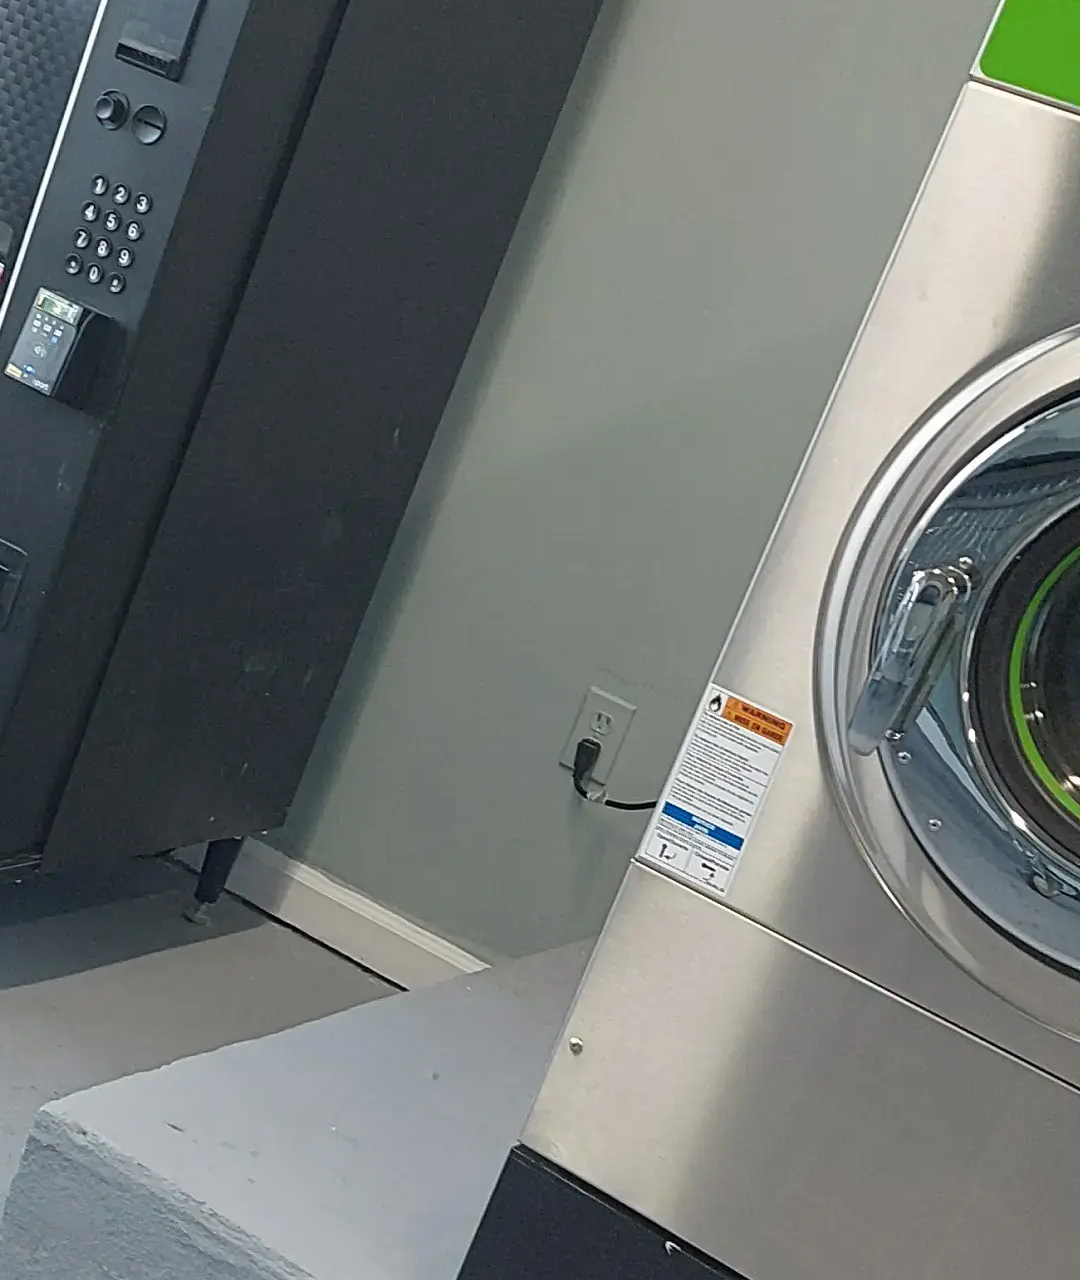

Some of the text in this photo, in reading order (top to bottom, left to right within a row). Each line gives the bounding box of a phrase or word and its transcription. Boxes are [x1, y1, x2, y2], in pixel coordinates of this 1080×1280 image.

[95, 178, 146, 209] 1 2 3
[85, 205, 138, 236] 4 5 6
[78, 232, 128, 262] 7 8 9
